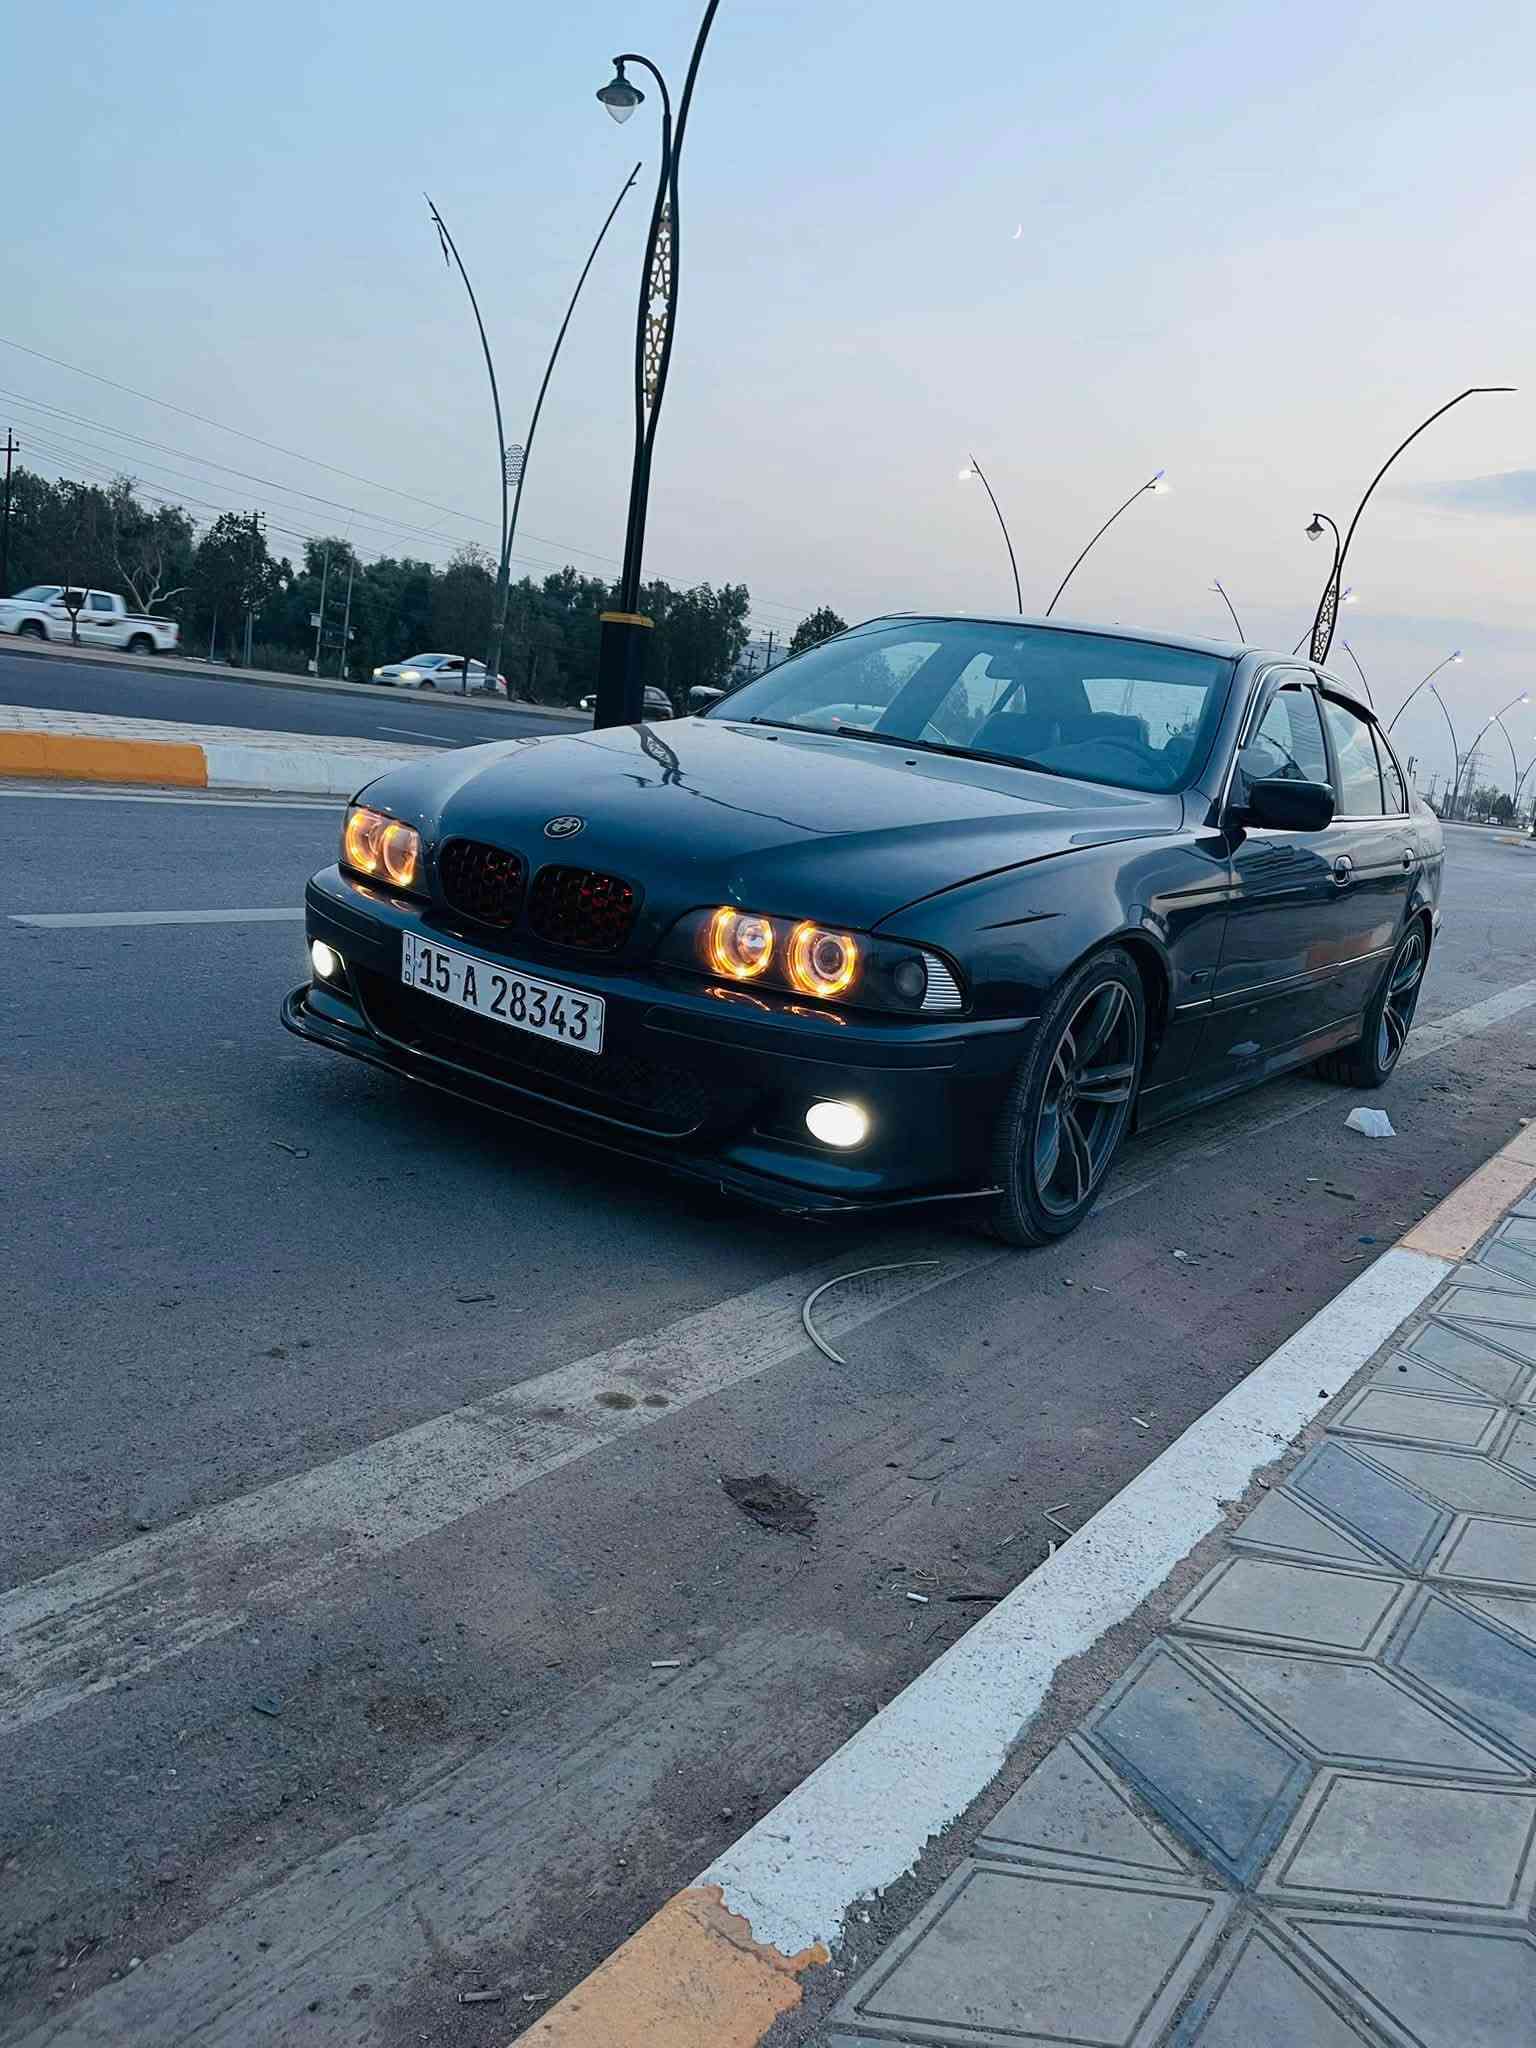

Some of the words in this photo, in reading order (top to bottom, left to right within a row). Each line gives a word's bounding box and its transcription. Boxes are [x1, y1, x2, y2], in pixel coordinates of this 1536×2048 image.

[420, 948, 450, 993] 15
[462, 965, 478, 1006] A
[491, 975, 589, 1041] 28343
